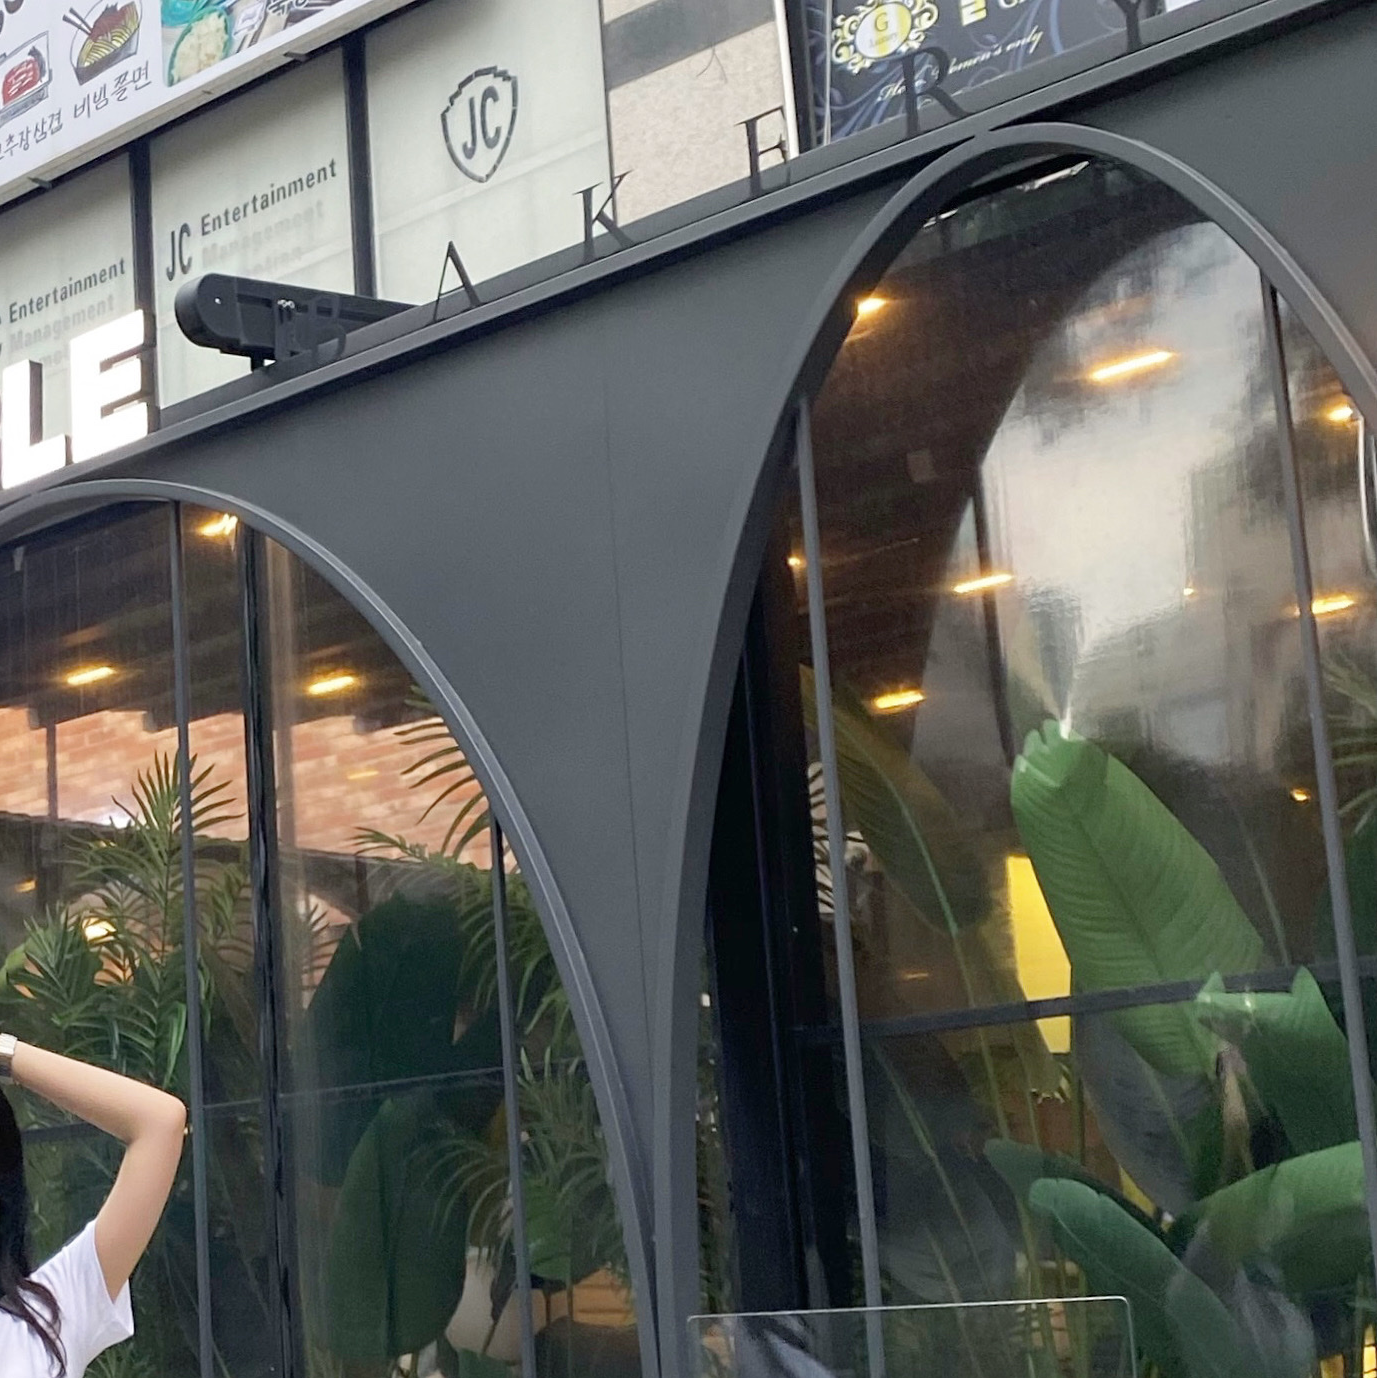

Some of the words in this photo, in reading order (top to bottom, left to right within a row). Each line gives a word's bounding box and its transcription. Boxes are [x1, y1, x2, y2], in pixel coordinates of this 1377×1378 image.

[462, 85, 502, 161] JC
[166, 222, 193, 282] JC
[200, 157, 337, 237] Entertainment
[8, 256, 126, 324] Entertainment
